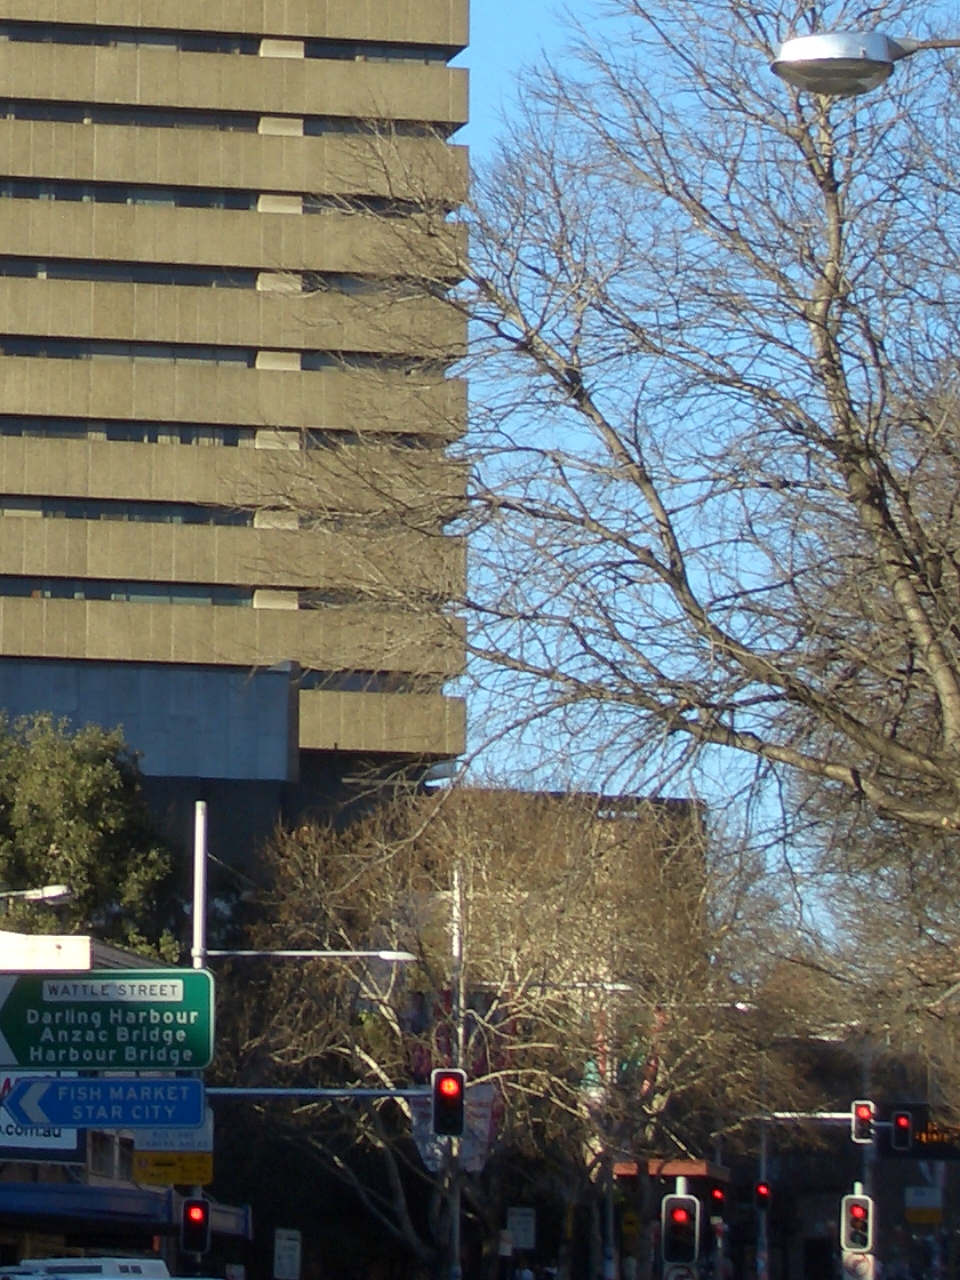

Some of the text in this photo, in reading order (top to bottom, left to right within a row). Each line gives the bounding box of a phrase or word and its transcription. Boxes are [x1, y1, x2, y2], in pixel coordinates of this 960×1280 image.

[47, 984, 178, 996] WATTLE STREET
[26, 1008, 199, 1028] Darling Harbour
[40, 1027, 187, 1046] Anzac Bridge
[30, 1046, 193, 1066] Harbour Bridge
[58, 1086, 191, 1101] FISH MARKET
[72, 1105, 177, 1120] STAR CITY
